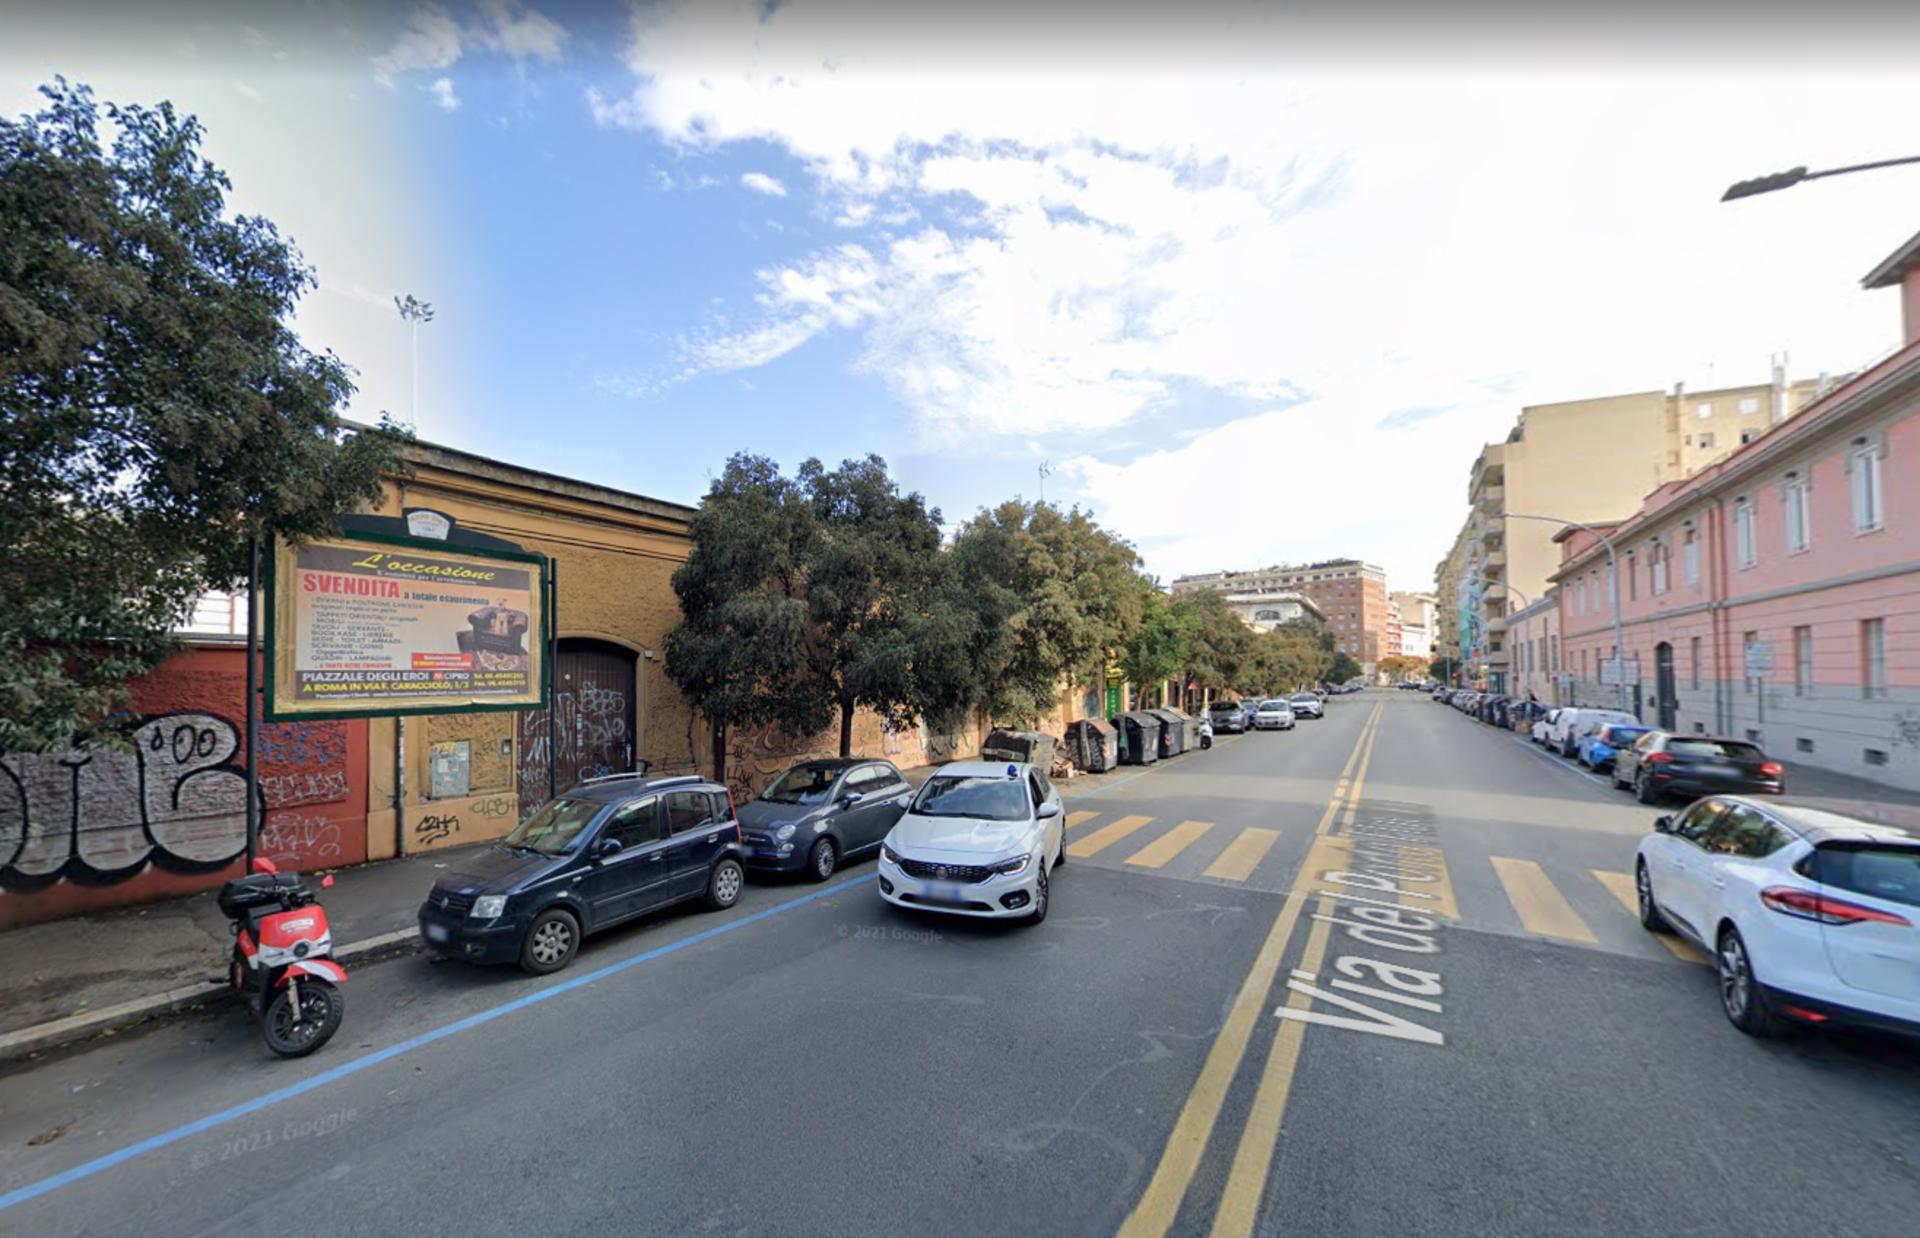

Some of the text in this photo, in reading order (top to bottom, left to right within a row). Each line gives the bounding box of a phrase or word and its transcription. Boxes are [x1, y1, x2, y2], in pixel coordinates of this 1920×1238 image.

[351, 552, 496, 581] L'occasione
[303, 573, 400, 599] SVENDITA
[412, 592, 438, 602] totale
[303, 672, 430, 683] PIAZZALE DEGLI EROI
[444, 672, 470, 681] CIPRO
[303, 683, 312, 693] A
[314, 683, 348, 692] ROMA
[350, 682, 362, 691] IN
